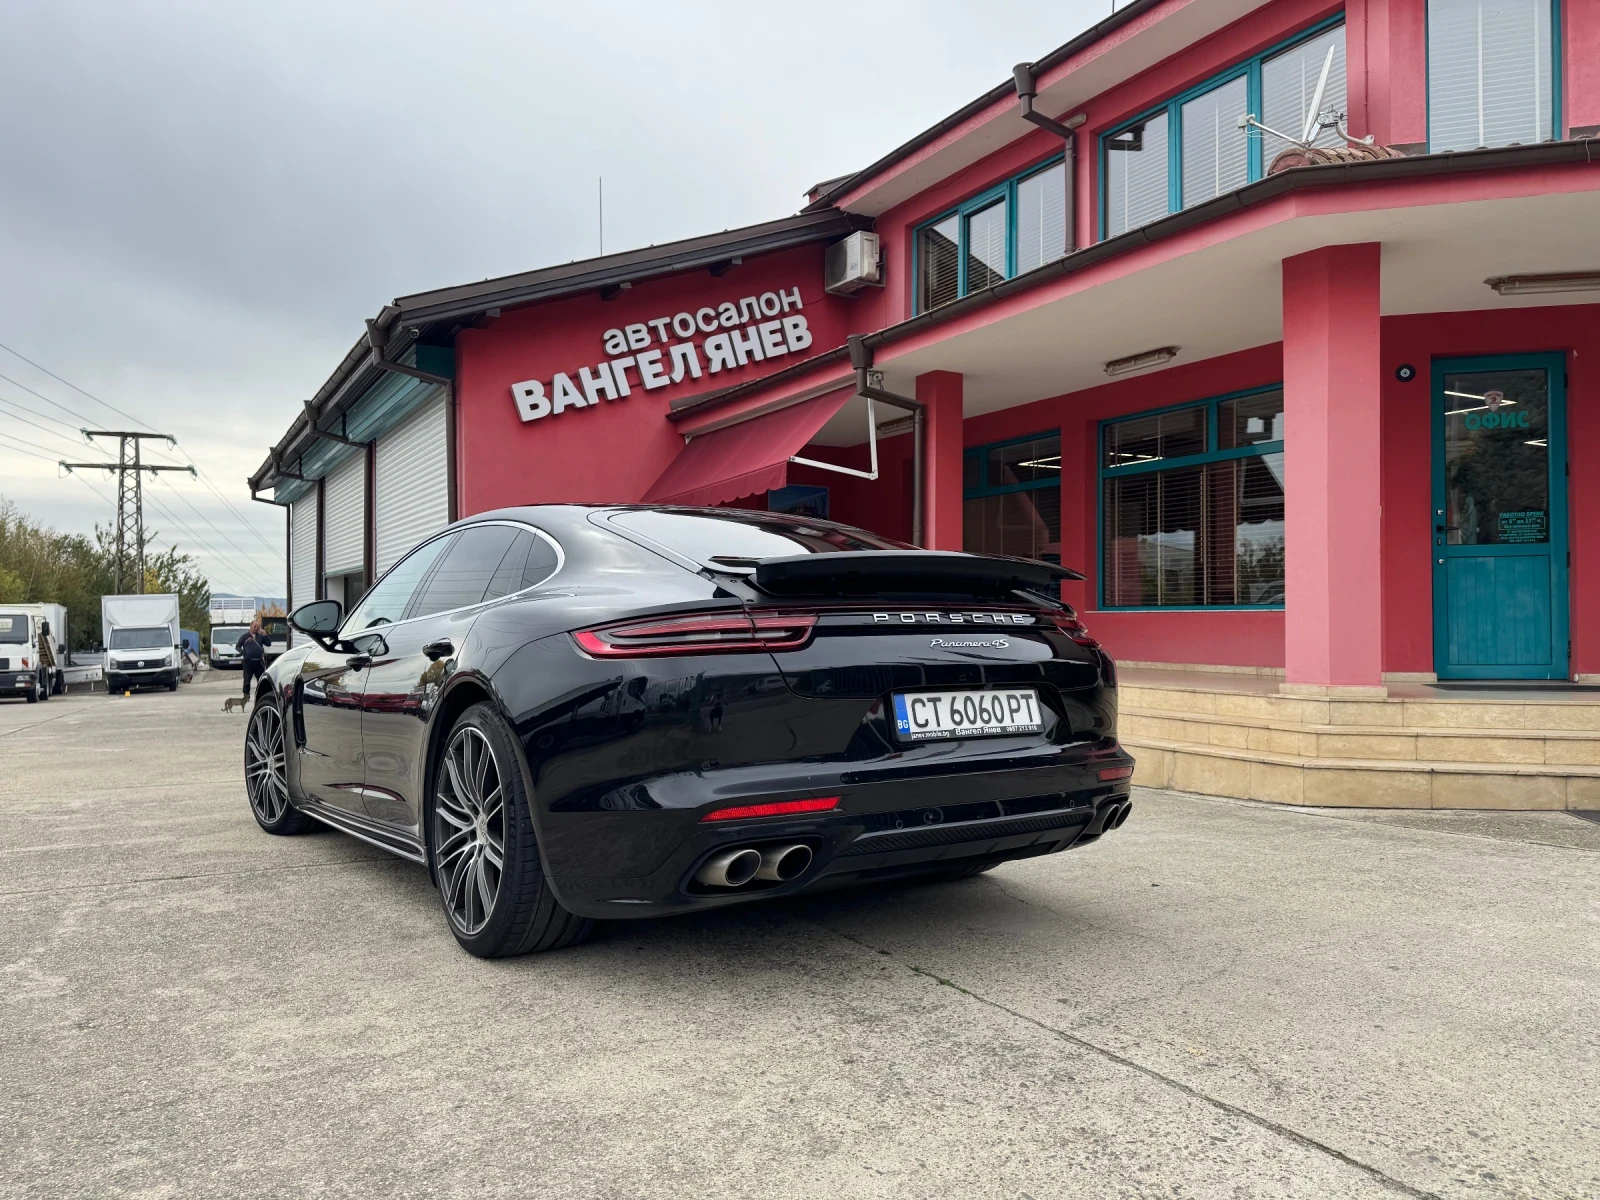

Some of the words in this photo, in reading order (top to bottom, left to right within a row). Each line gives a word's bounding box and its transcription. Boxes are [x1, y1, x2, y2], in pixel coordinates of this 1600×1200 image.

[603, 286, 803, 356] автосалон
[510, 342, 702, 423] ВАНГЕЛ
[703, 314, 812, 374] ЯНЕВ
[1464, 410, 1530, 431] ОФИС
[872, 613, 1025, 623] PORSCHE
[929, 638, 990, 648] Panamera
[911, 696, 942, 728] CT
[950, 694, 1005, 726] 6060
[1006, 693, 1034, 724] PT
[897, 719, 909, 730] BG
